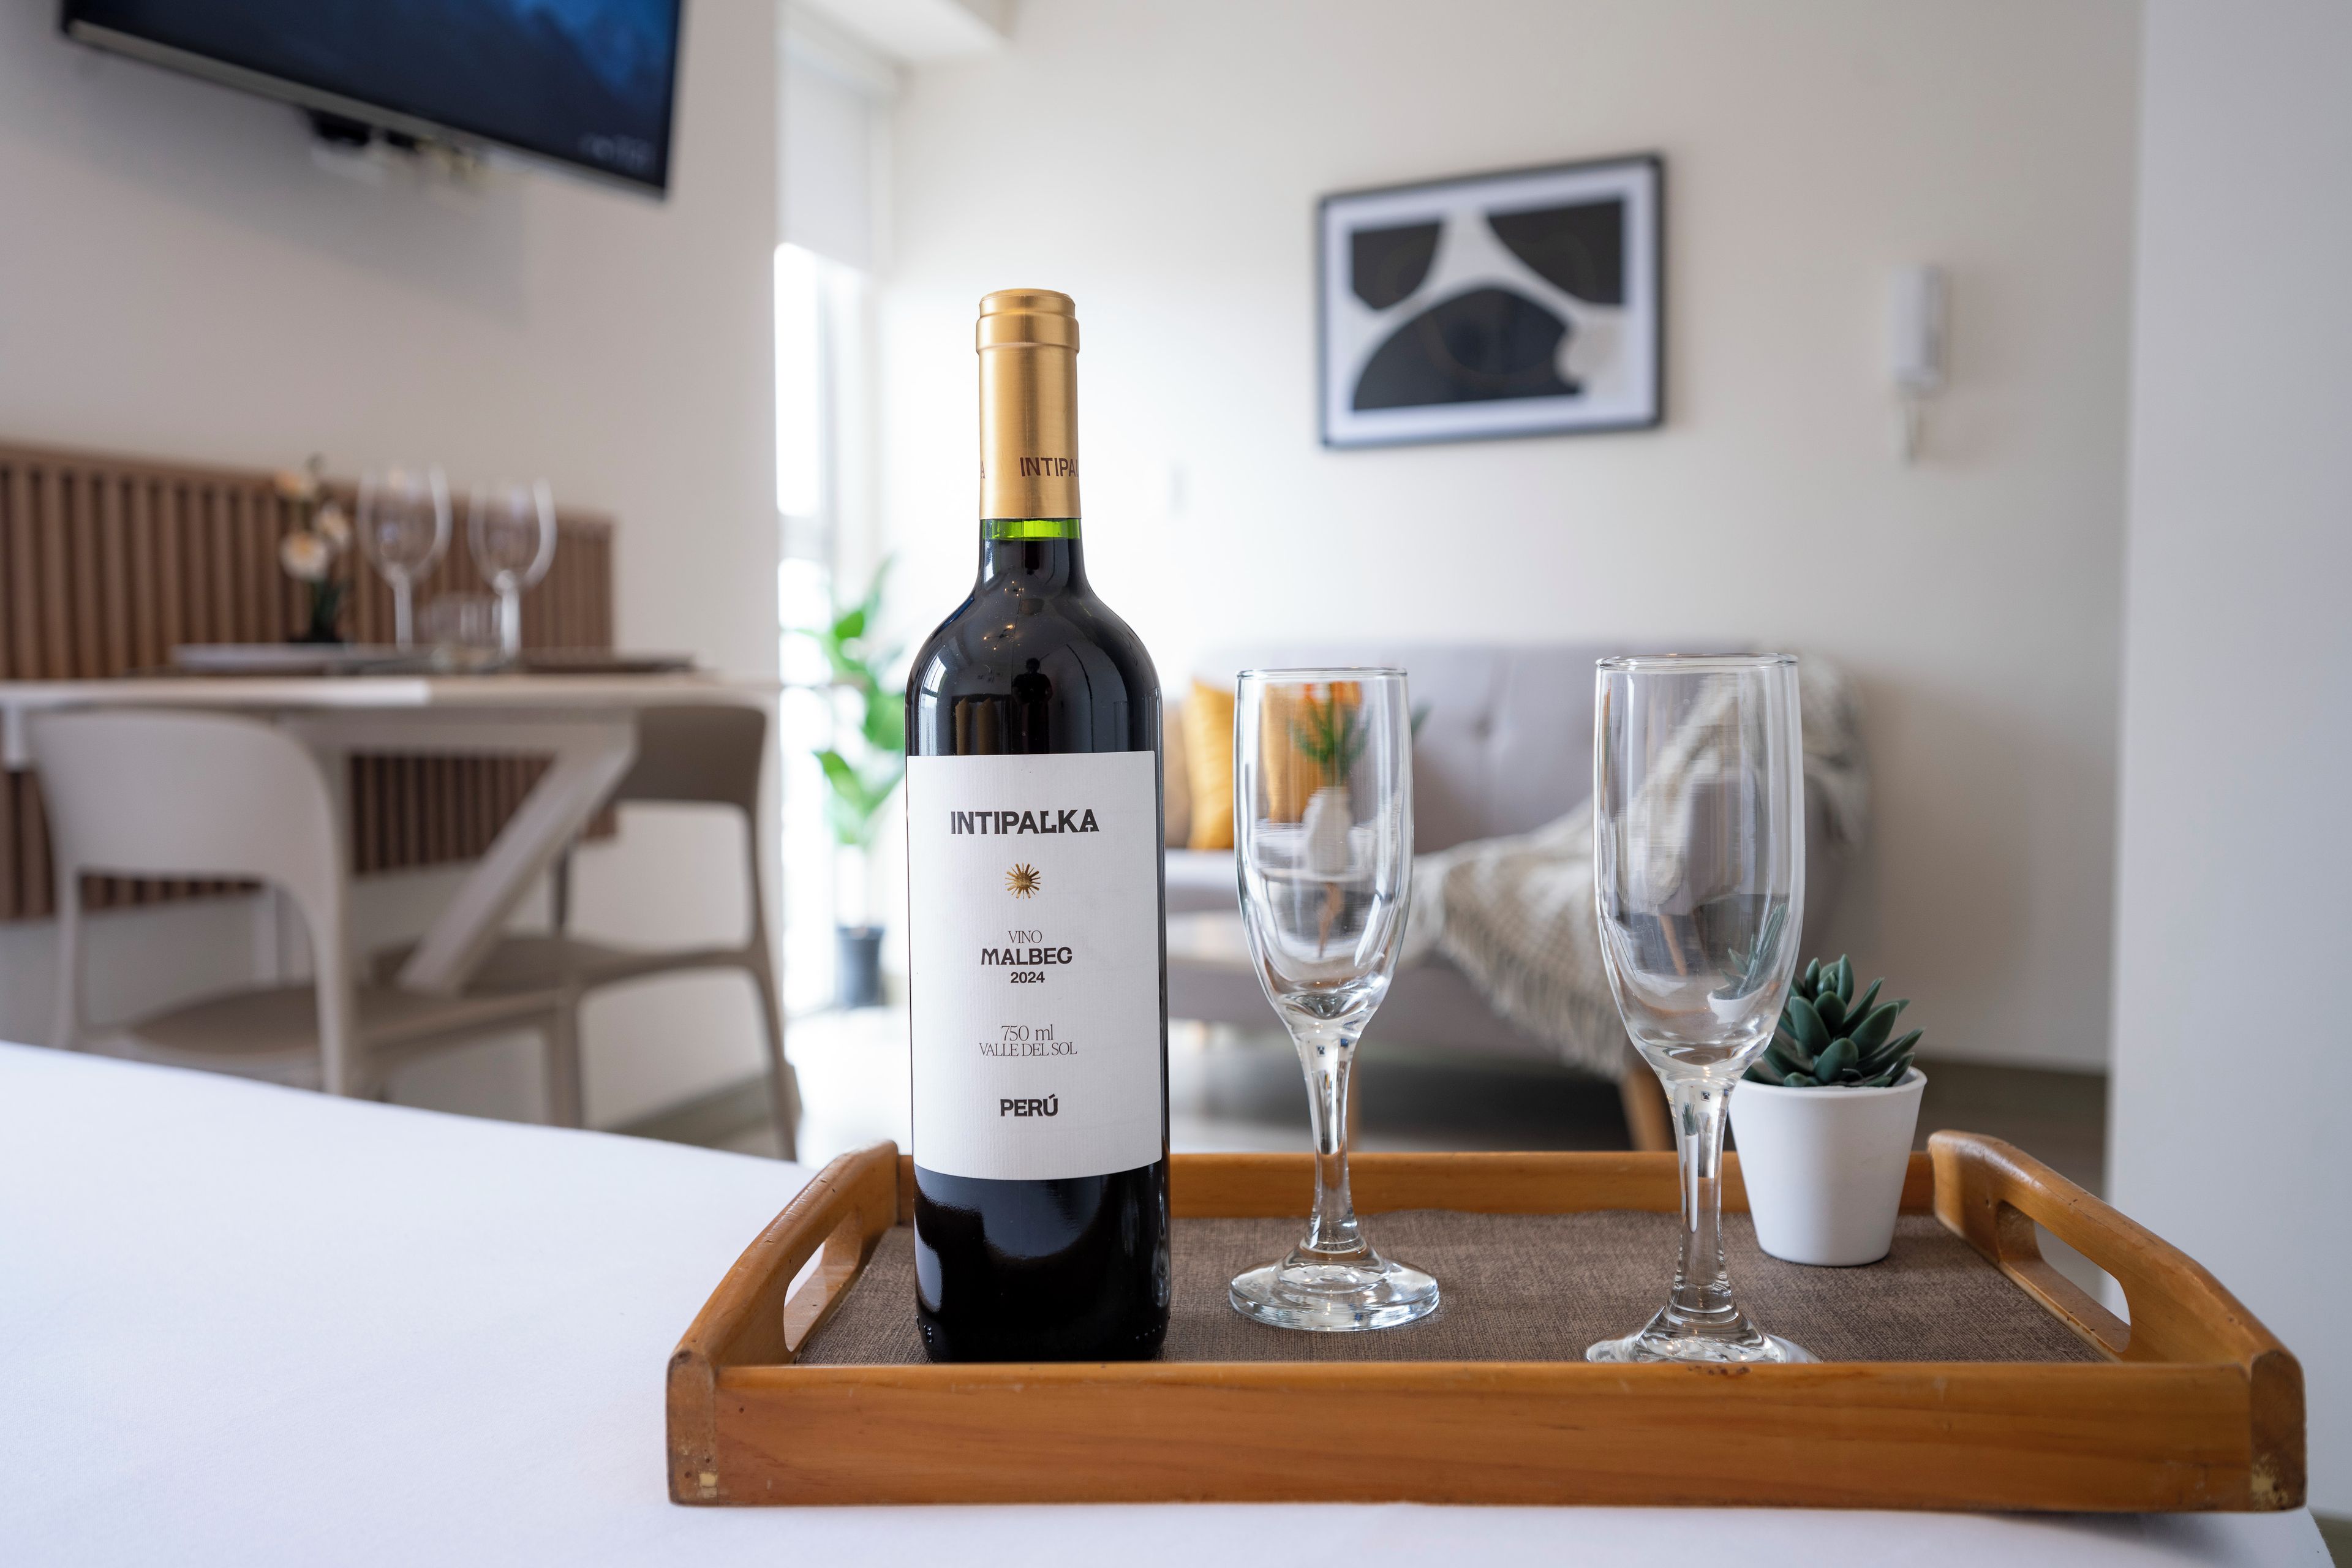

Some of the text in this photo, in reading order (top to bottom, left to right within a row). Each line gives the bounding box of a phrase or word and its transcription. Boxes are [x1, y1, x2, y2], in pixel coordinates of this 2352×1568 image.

[950, 809, 1099, 835] INTIPALKA
[1008, 930, 1042, 944] VINO
[981, 947, 1072, 966] MALBEC
[1010, 971, 1045, 984] 2024
[1001, 1023, 1054, 1042] 750 ml
[979, 1041, 1078, 1057] VALLE DEL SOL
[1000, 1093, 1058, 1117] PERÚ
